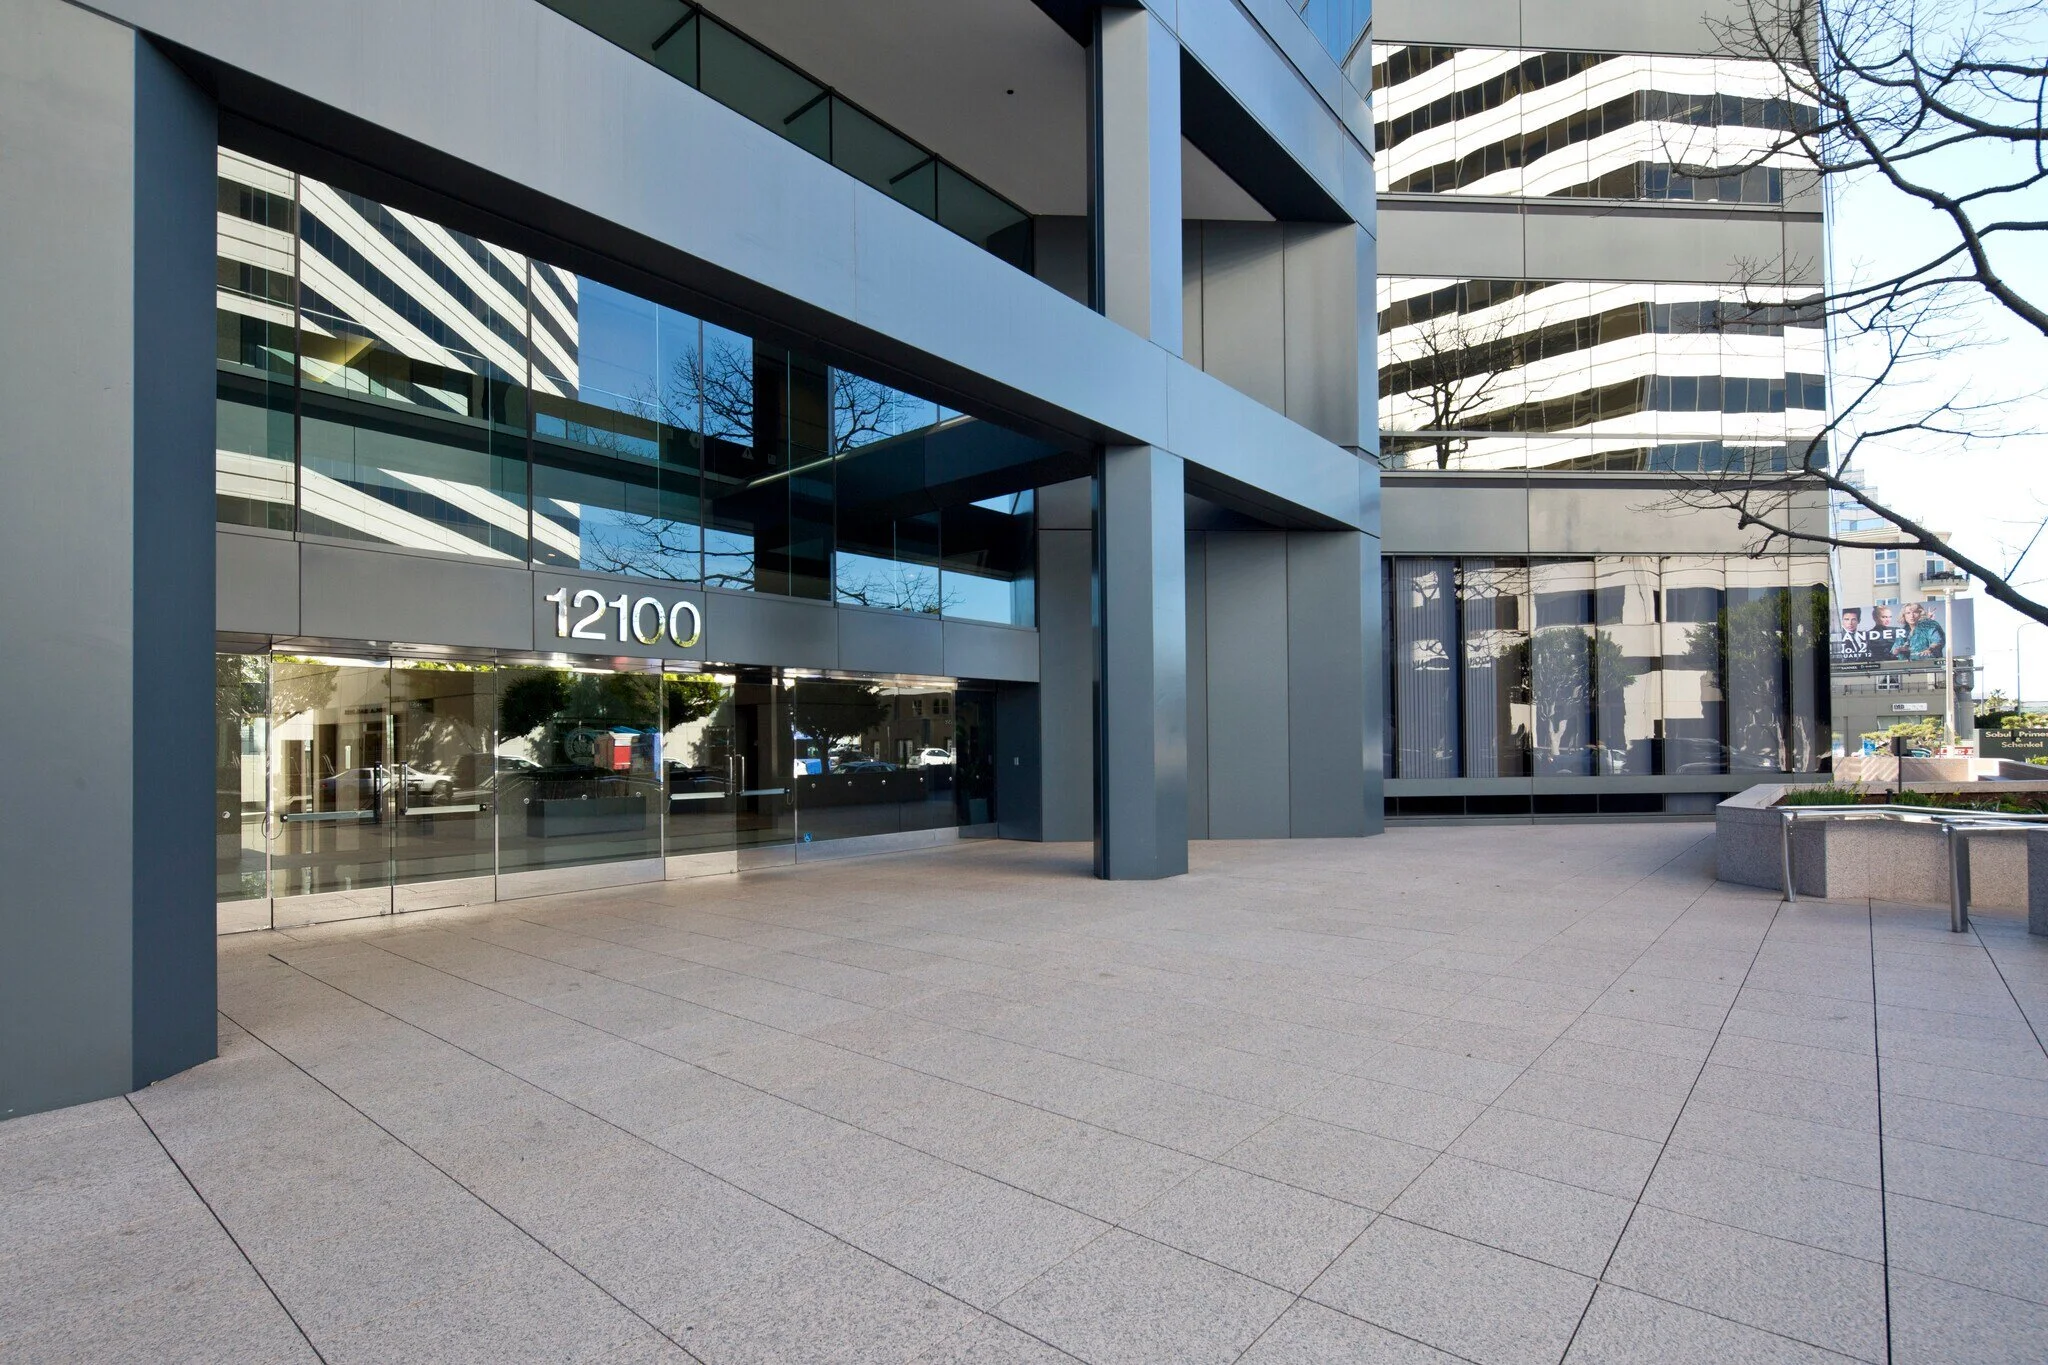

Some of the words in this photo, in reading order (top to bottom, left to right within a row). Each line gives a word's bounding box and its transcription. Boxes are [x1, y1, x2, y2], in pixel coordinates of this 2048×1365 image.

[546, 587, 701, 648] 12100
[1842, 629, 1907, 642] ANDER
[1858, 642, 1867, 653] 2
